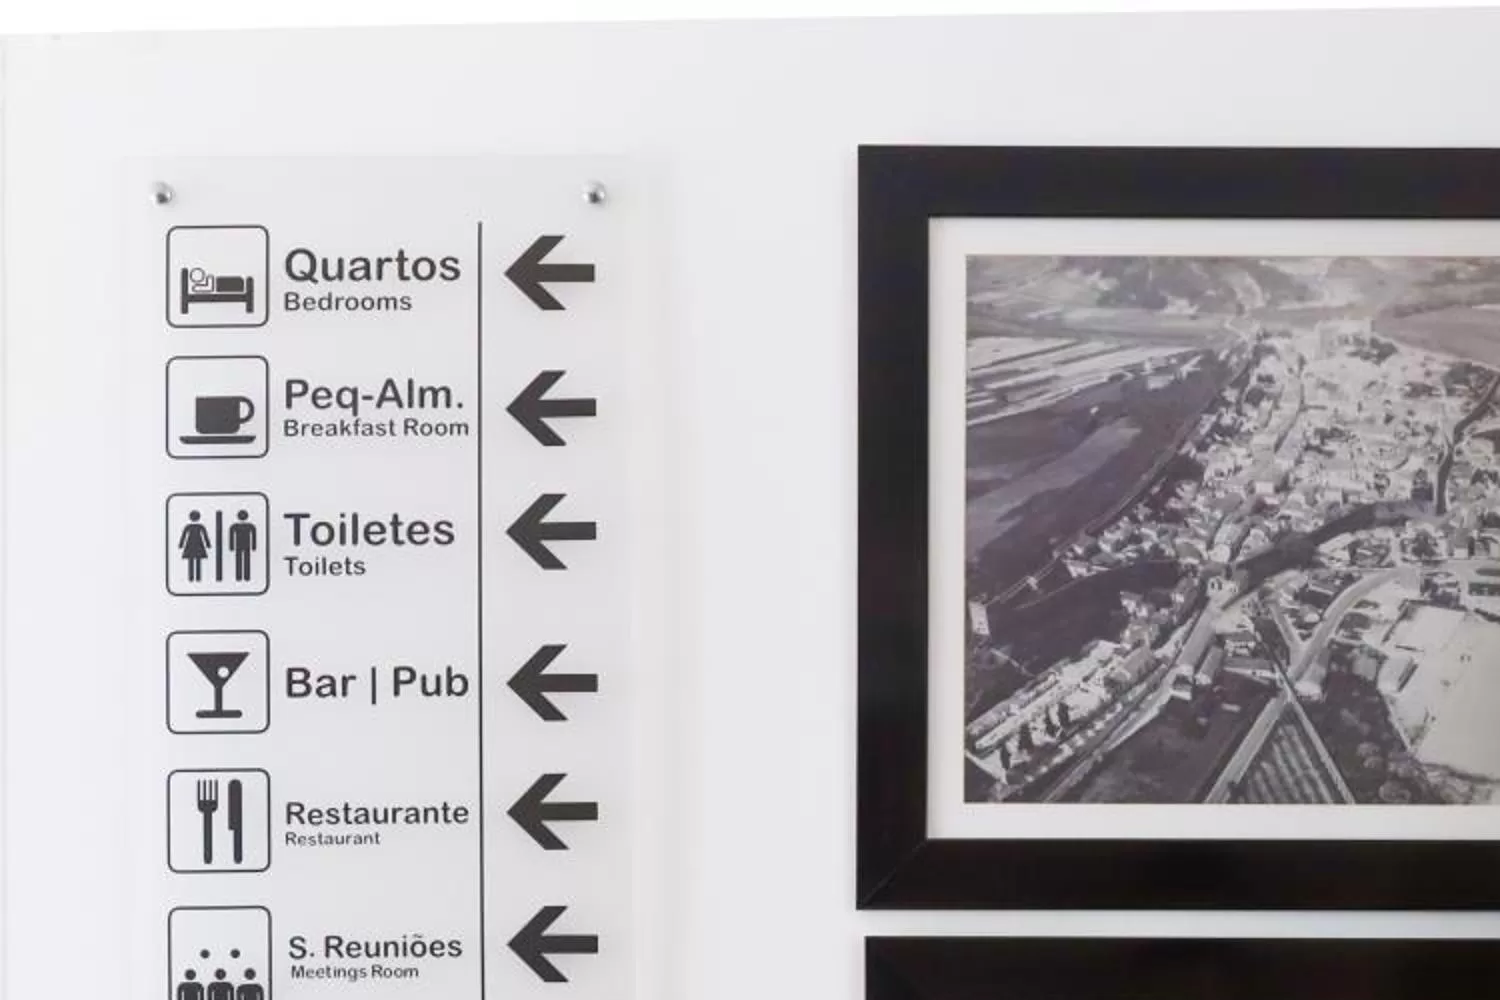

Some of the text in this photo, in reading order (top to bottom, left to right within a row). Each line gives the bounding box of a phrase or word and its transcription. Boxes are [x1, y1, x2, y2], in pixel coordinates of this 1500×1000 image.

[285, 247, 460, 283] Quartos
[284, 292, 412, 312] Bedrooms
[285, 378, 464, 416] Peq-Alm.
[284, 418, 470, 437] Breakfast Room
[284, 512, 455, 547] Toiletes
[283, 556, 366, 577] Toilets
[286, 667, 357, 698] Bar
[393, 665, 469, 698] Pub
[286, 801, 469, 826] Restaurante
[285, 832, 380, 847] Restaurant
[289, 933, 463, 959] S. Reuniões
[291, 965, 419, 982] Meetings Room
